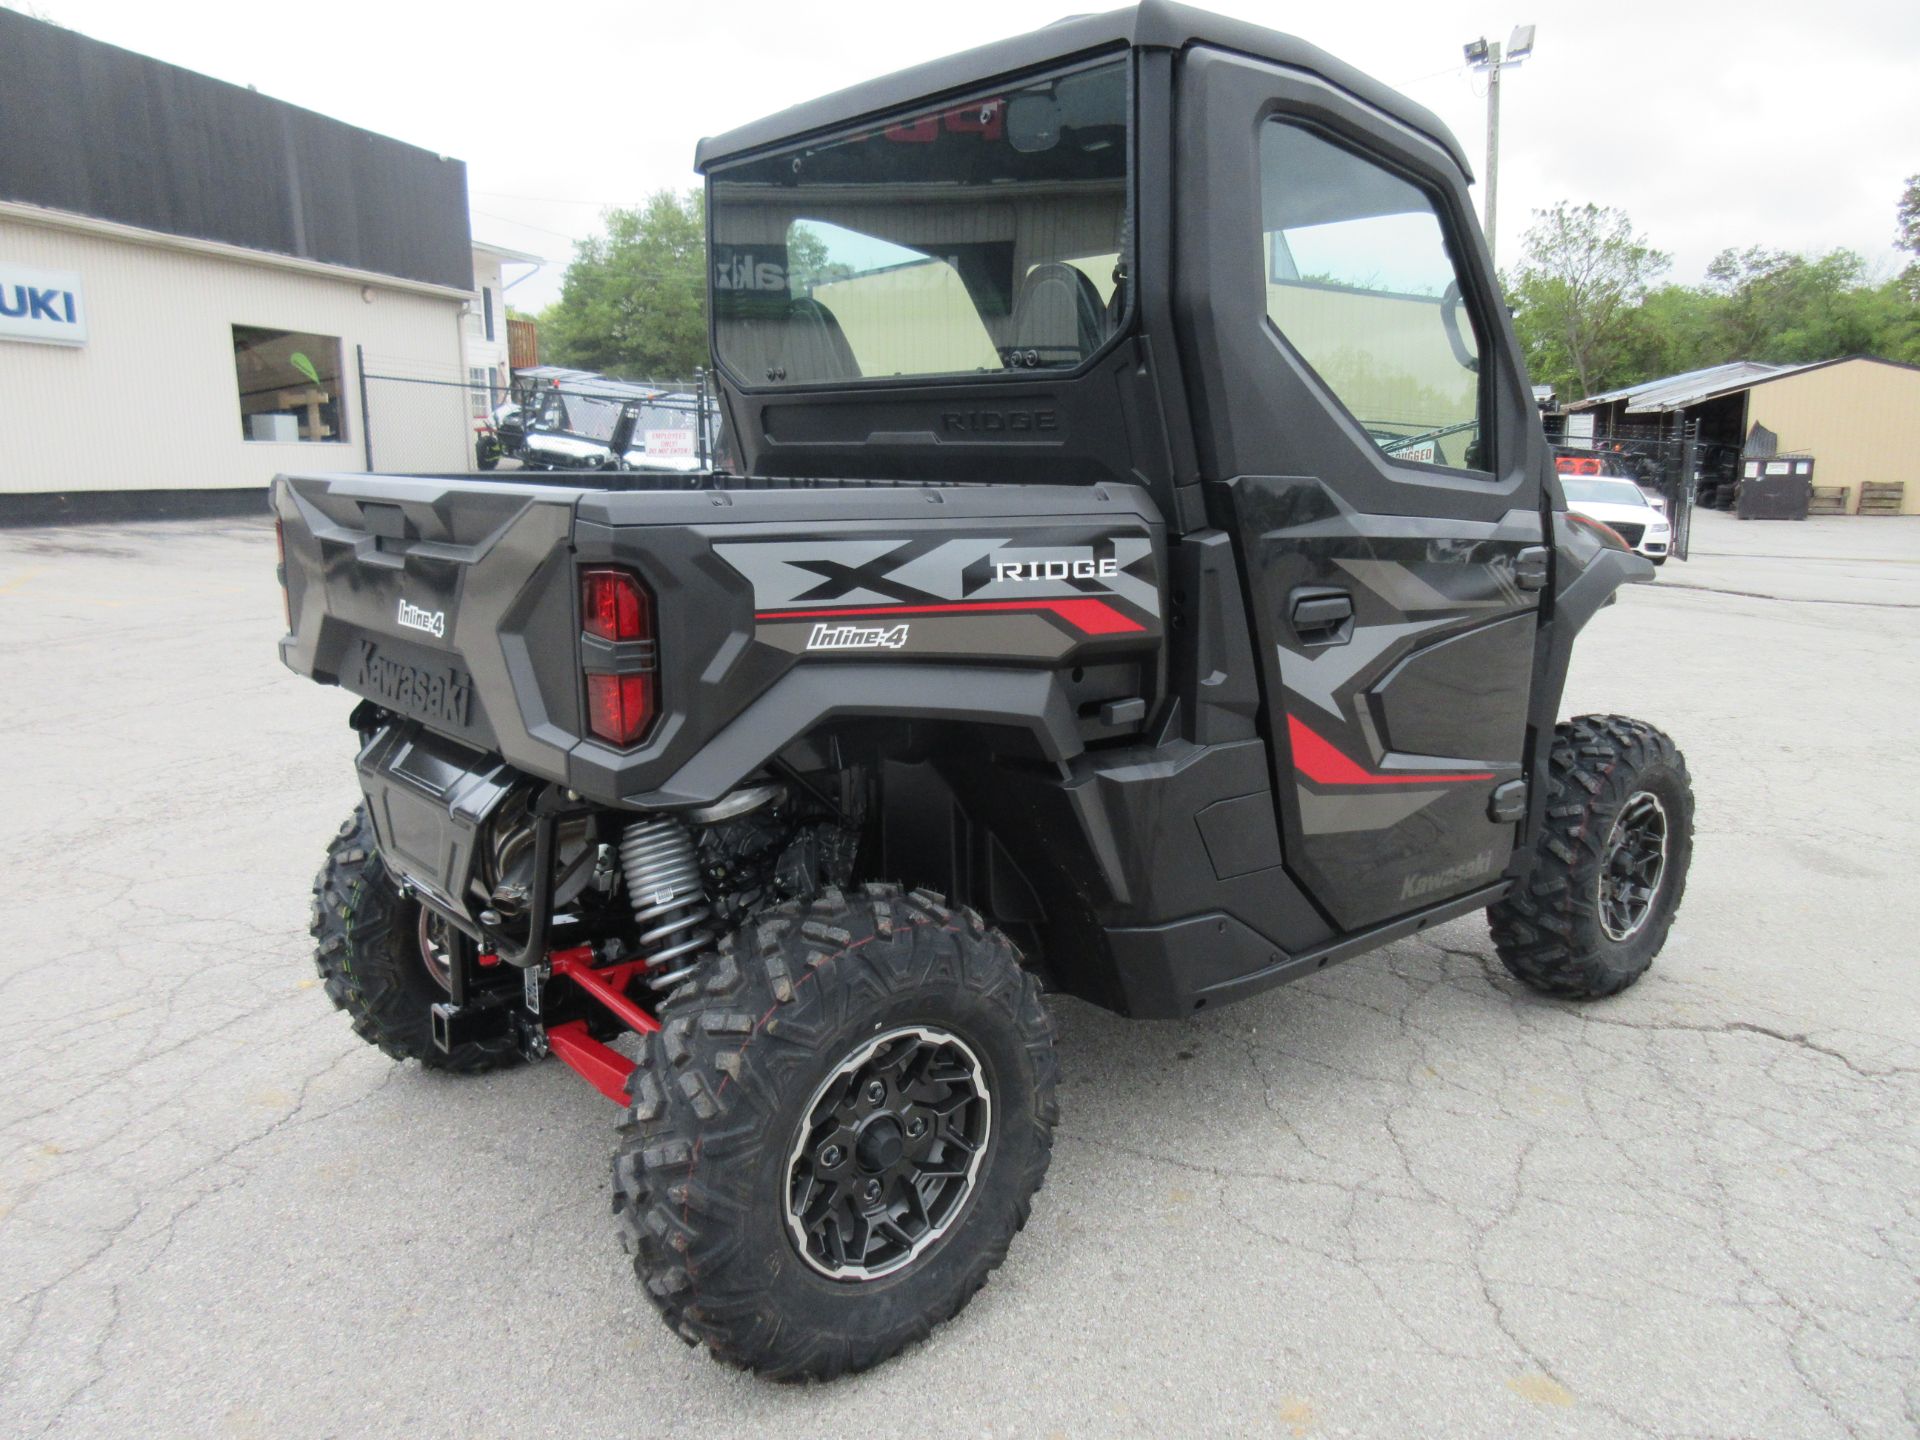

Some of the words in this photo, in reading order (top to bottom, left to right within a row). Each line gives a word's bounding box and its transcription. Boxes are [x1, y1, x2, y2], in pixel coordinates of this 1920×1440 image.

[941, 410, 1058, 432] RIDGE
[996, 558, 1118, 583] RIDGE
[398, 599, 445, 638] Inline-4
[806, 623, 909, 650] Inline-4
[359, 640, 472, 728] Kawasaki
[1400, 848, 1492, 900] Kawasaki
